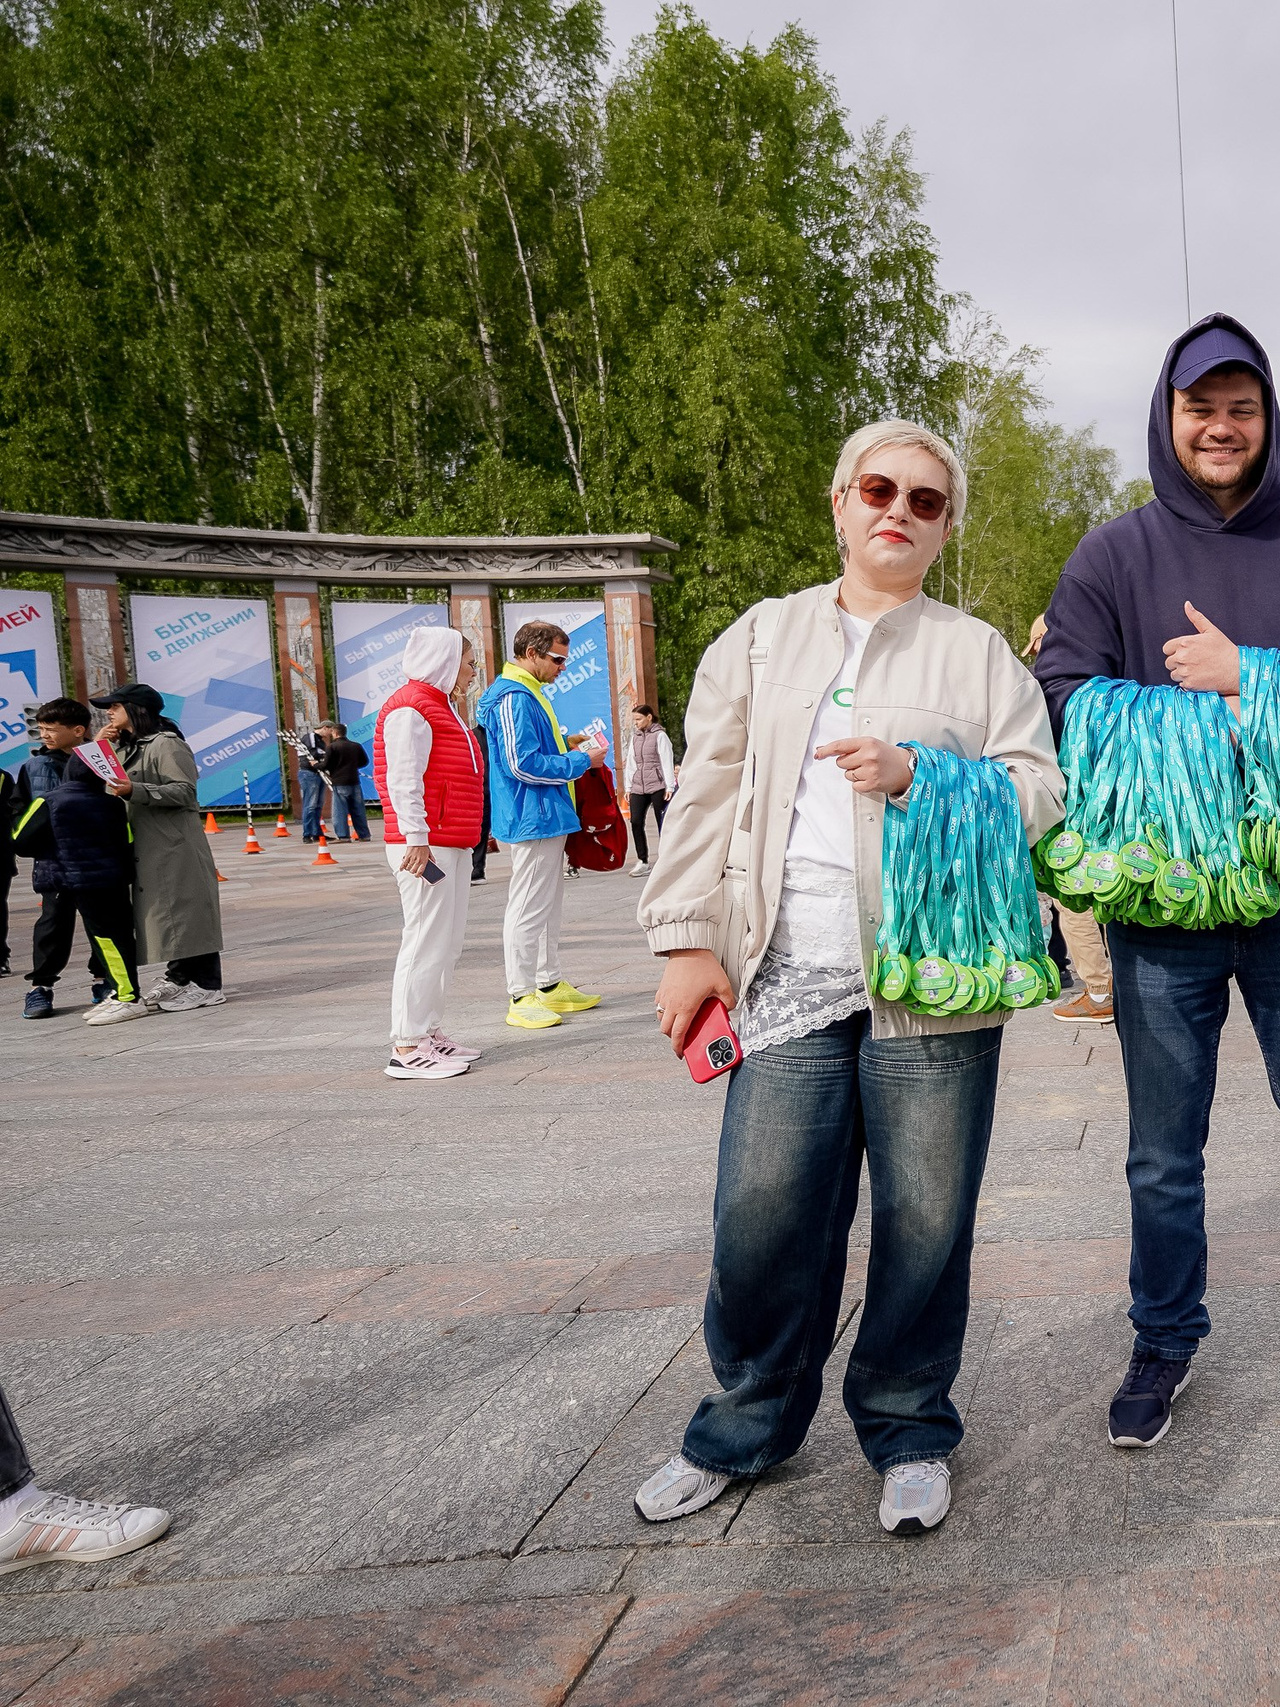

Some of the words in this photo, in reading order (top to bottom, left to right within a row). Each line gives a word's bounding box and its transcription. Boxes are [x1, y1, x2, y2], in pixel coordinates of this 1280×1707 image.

[154, 611, 211, 640] БЫТЬ
[554, 612, 582, 629] АЛЬ
[147, 650, 162, 662] В
[165, 608, 256, 657] ДВИЖЕНИИ
[344, 641, 383, 664] БЫТЬ
[384, 612, 439, 644] ВМЕСТЕ
[565, 638, 598, 666] ЕНИЕ
[541, 657, 603, 701] РВЫХ
[366, 689, 377, 701] С
[1207, 722, 1215, 738] 2026
[204, 728, 271, 767] СМЕЛЫМ
[90, 753, 112, 776] 2812
[913, 783, 921, 802] 2026
[1155, 785, 1163, 802] 2026
[1183, 782, 1191, 799] 2026
[1204, 787, 1212, 803] 2026
[949, 816, 958, 836] 2026
[916, 871, 924, 890] 2026
[991, 885, 1000, 903] 2026
